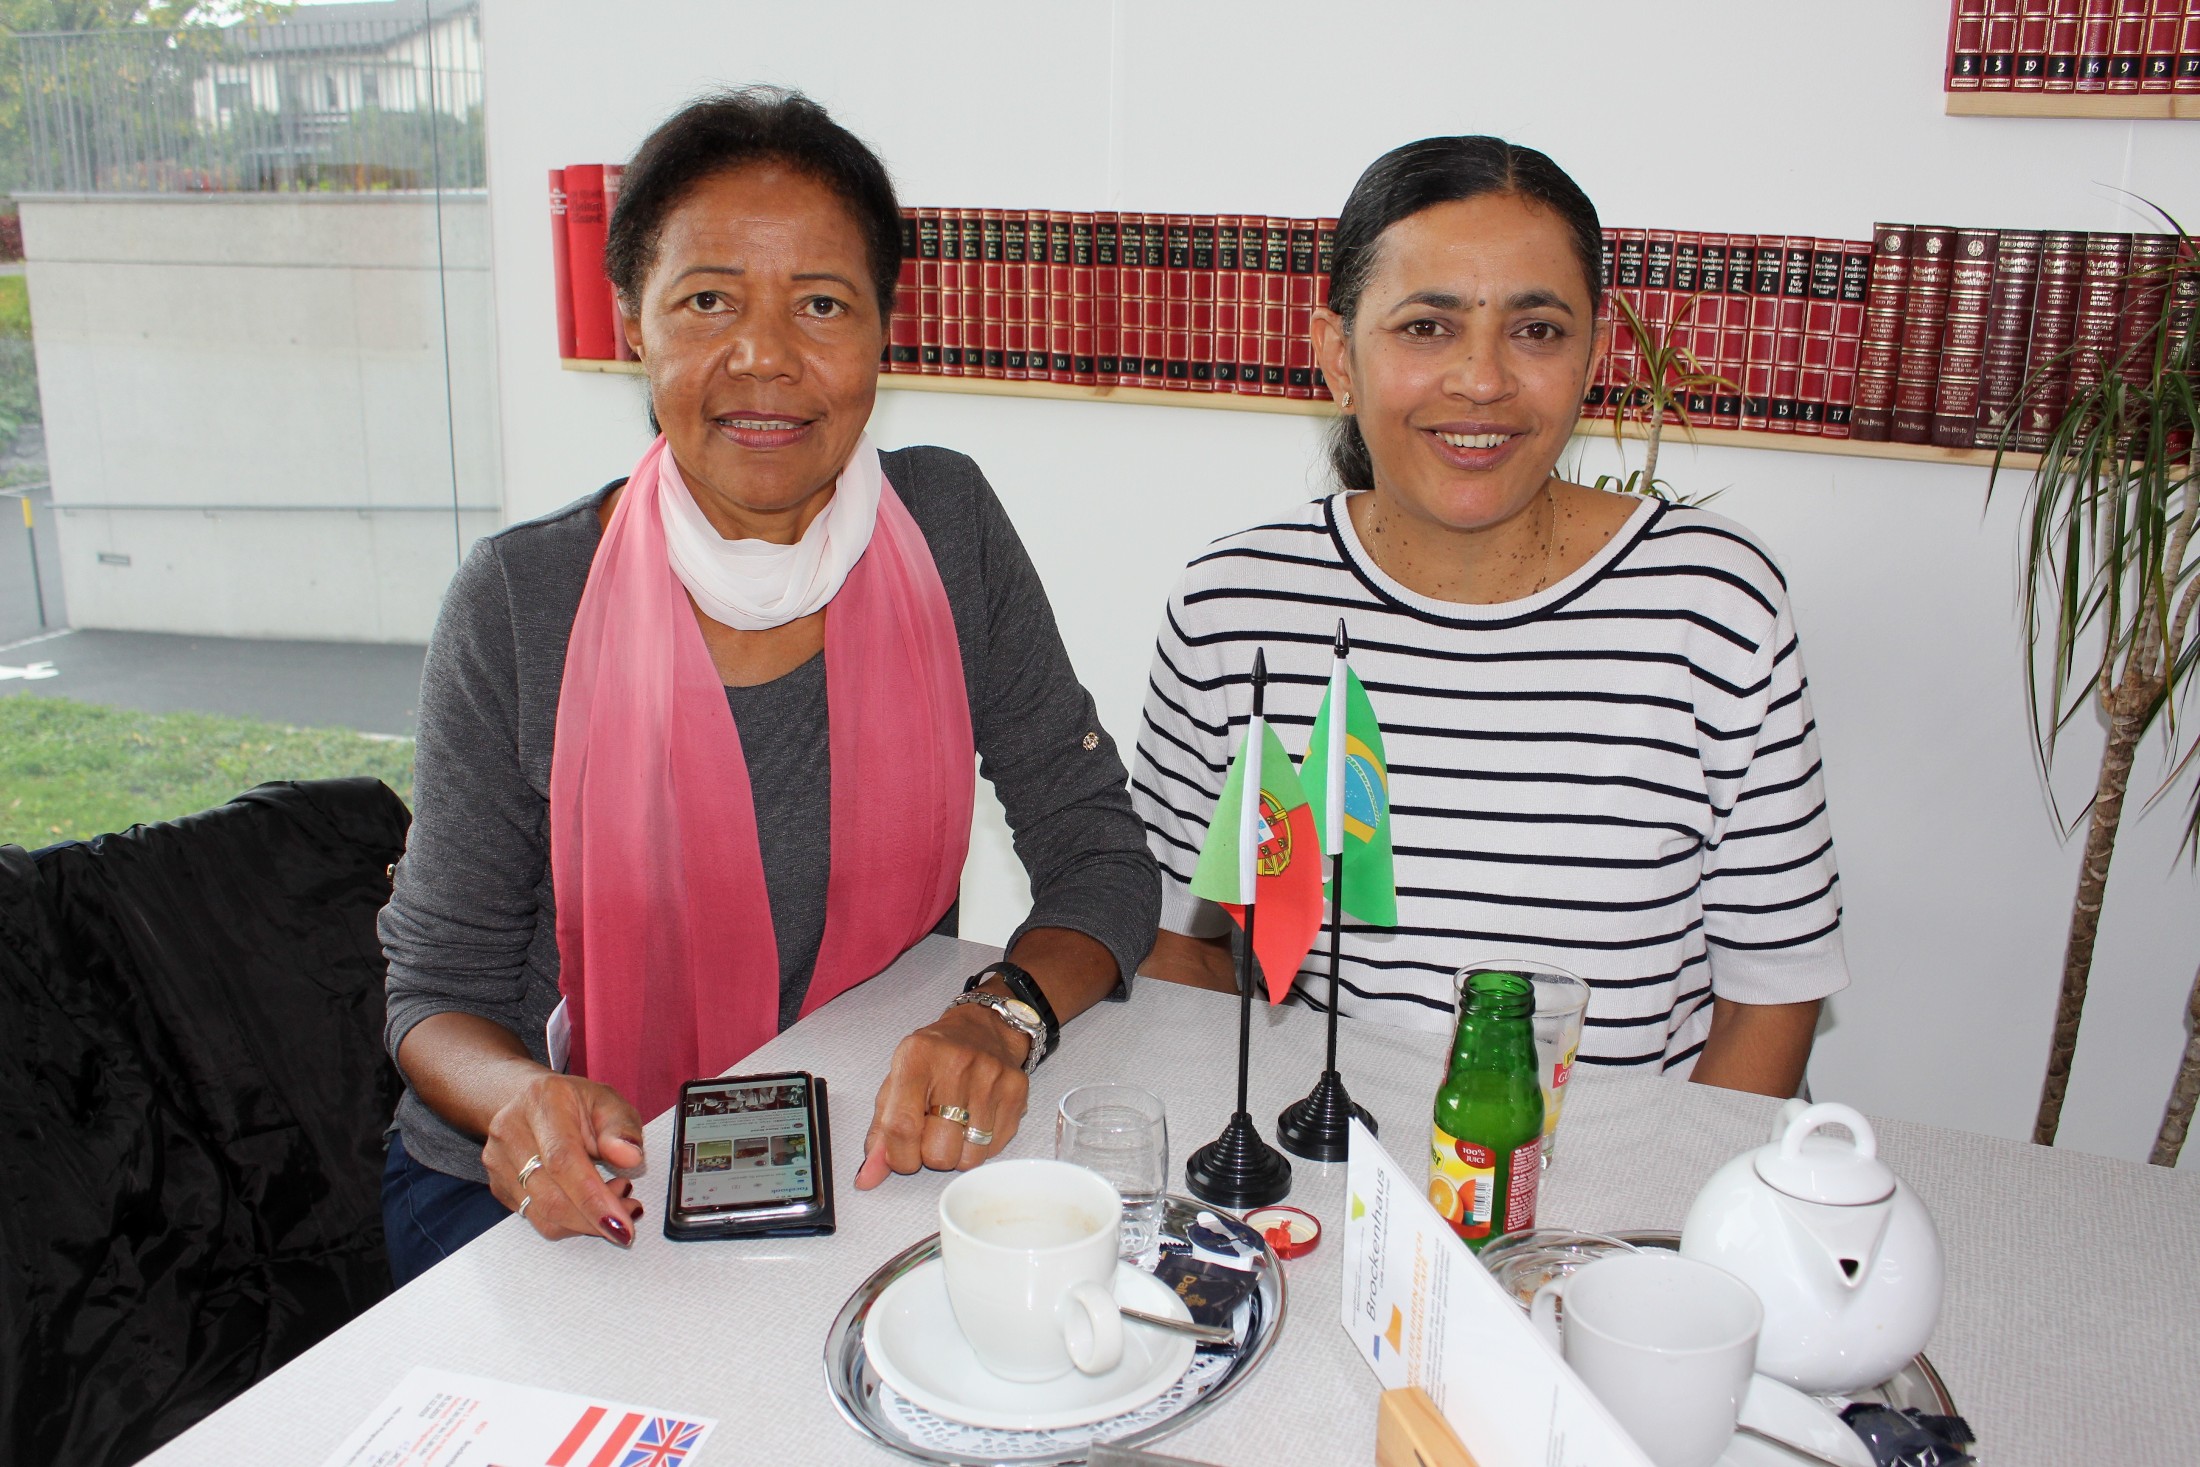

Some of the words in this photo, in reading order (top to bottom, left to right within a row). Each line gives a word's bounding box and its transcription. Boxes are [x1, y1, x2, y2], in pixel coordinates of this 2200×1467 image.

[1963, 60, 1971, 72] 3
[1995, 60, 2002, 71] 5
[2024, 60, 2037, 71] 19
[2057, 62, 2065, 73] 2
[2087, 61, 2099, 74] 16
[2121, 62, 2130, 73] 9
[2154, 61, 2166, 73] 15
[2186, 60, 2200, 71] 17
[1011, 356, 1020, 366] 17
[1033, 356, 1043, 366] 20
[1056, 358, 1066, 368] 10
[1126, 362, 1135, 371] 12
[1149, 363, 1156, 373] 4
[1174, 365, 1179, 374] 1
[1221, 367, 1228, 376] 9
[1198, 367, 1204, 377] 6
[1244, 368, 1254, 378] 19
[1268, 370, 1277, 380] 12
[1295, 373, 1302, 382] 2
[1694, 399, 1705, 410] 14
[1723, 402, 1730, 412] 2
[1753, 403, 1758, 413] 1
[1778, 404, 1789, 415] 15
[1832, 410, 1844, 421] 17
[1462, 1147, 1486, 1157] 100%
[1466, 1155, 1486, 1165] JUICE
[1366, 1167, 1385, 1322] Brockenhaus
